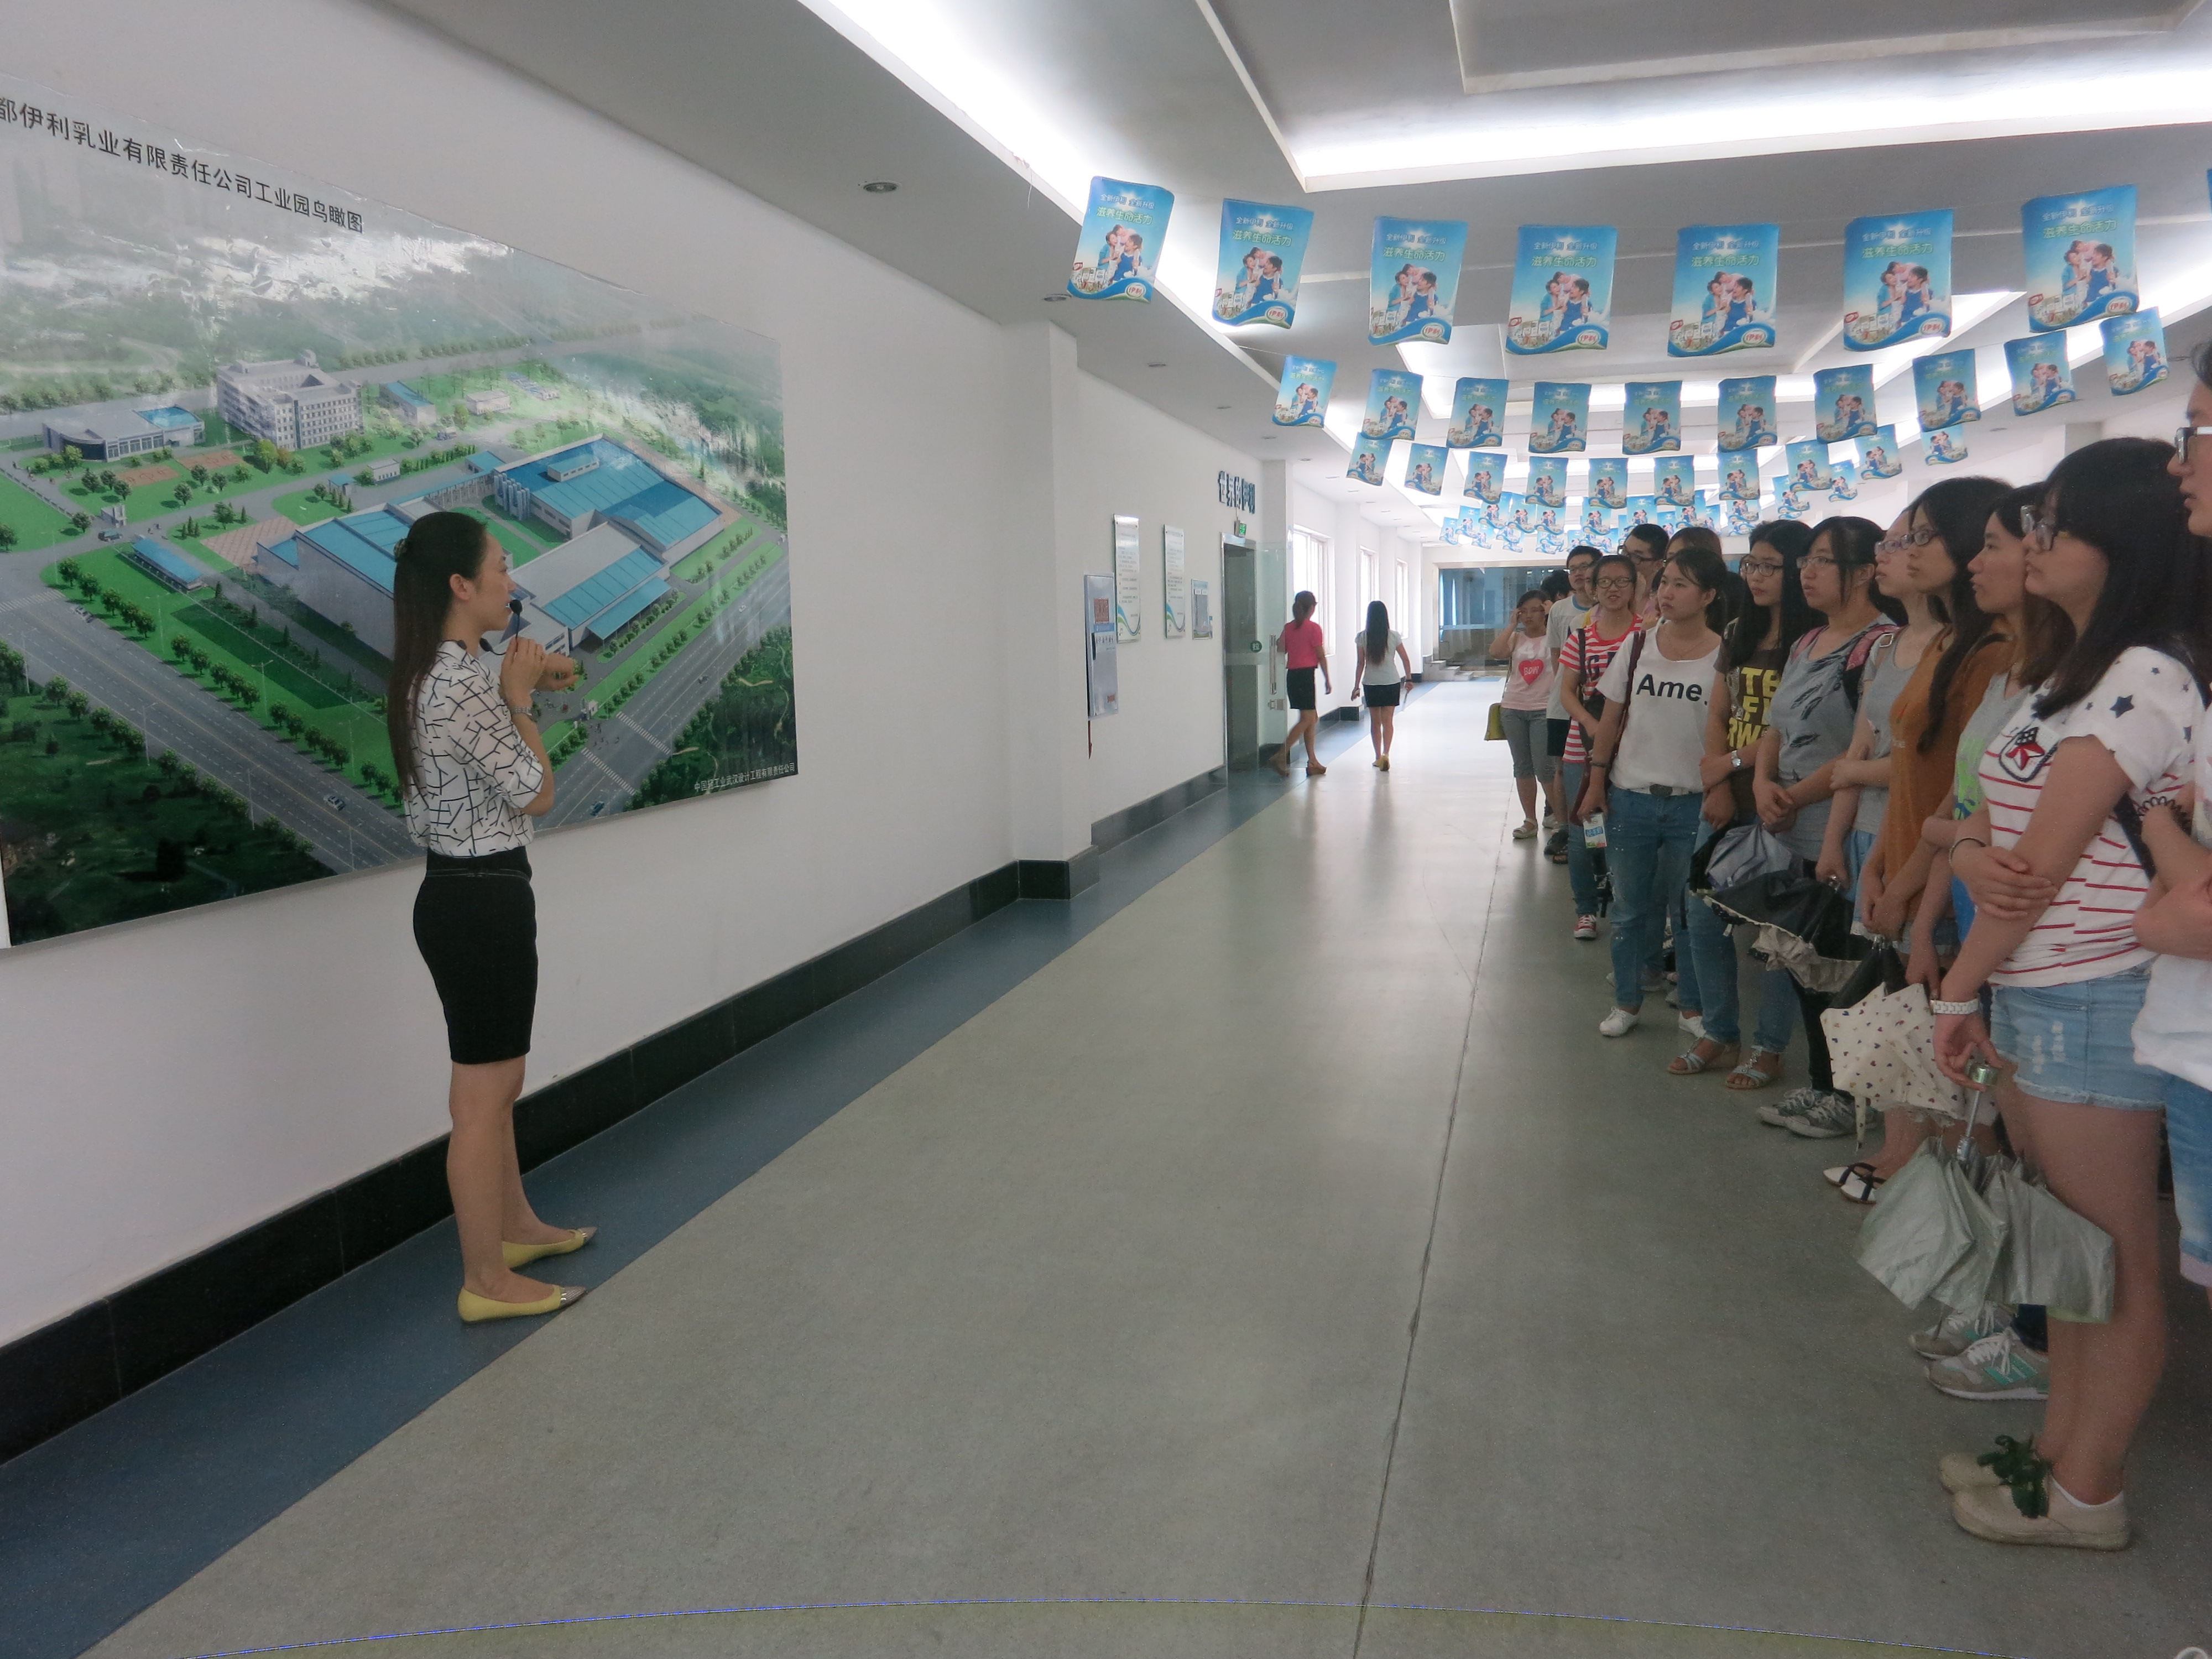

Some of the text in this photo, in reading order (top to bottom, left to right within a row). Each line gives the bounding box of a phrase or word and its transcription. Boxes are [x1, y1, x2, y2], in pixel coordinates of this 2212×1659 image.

[1097, 206, 1153, 225] 滋养生命活力
[1232, 229, 1292, 246] 滋养生命活力
[1383, 247, 1446, 262] 滋养生命活力
[1531, 255, 1597, 268] 滋养生命活力
[1128, 286, 1143, 295] 伊利
[1636, 674, 1708, 706] Ame.
